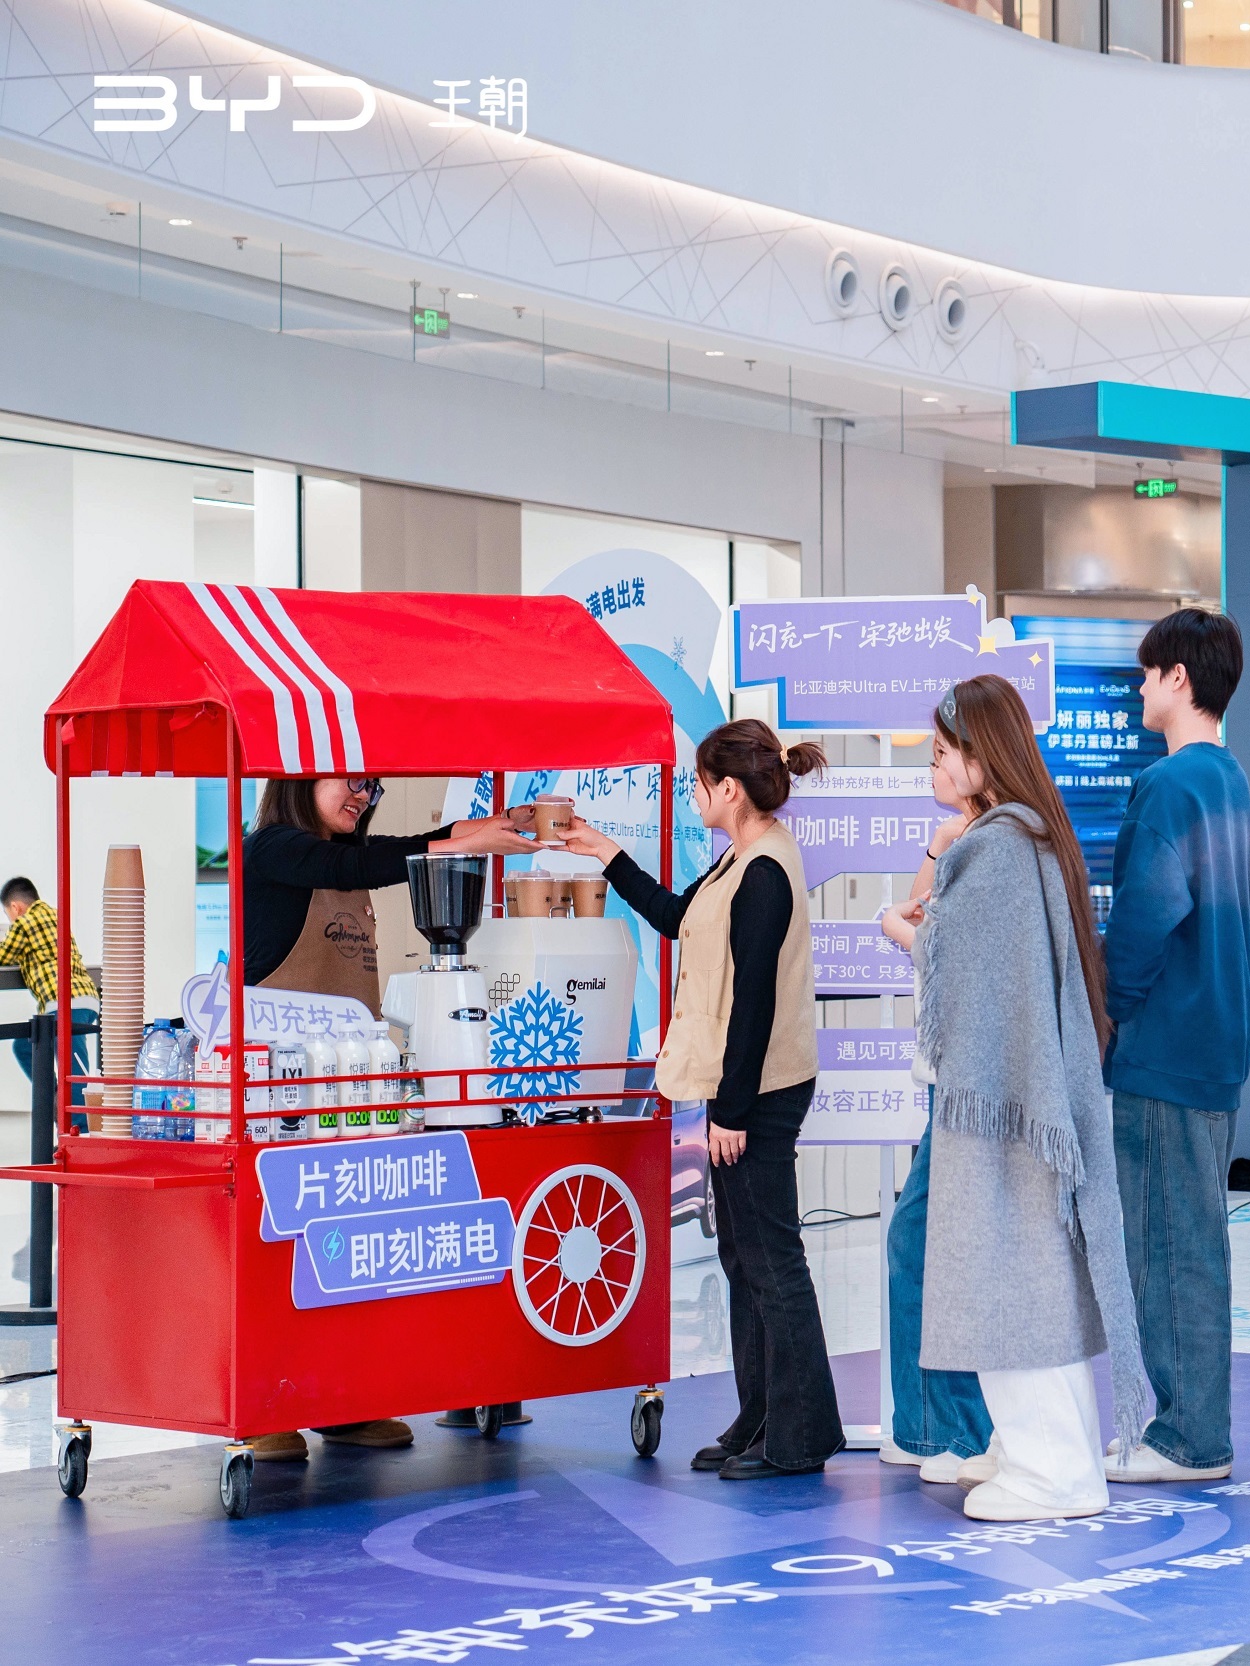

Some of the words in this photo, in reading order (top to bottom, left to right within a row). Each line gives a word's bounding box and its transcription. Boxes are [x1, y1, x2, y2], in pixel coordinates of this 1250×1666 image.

[586, 577, 646, 620] 满电出发
[748, 620, 860, 654] 闪充一下
[858, 615, 975, 653] 宋弛出发
[793, 680, 887, 696] 比亚迪宋Ultra
[1056, 710, 1129, 731] 妍丽独家
[1047, 734, 1139, 750] 伊菲丹重磅上新
[811, 776, 884, 789] 5分钟充好电
[869, 815, 954, 847] 即可
[812, 935, 850, 954] 时间
[565, 978, 606, 1006] gemilai
[249, 997, 363, 1041] 闪充技术
[837, 1041, 918, 1061] 遇见可爱
[811, 1088, 905, 1113] 妆容正好
[255, 1126, 268, 1134] 600
[295, 1149, 448, 1211] 片刻咖啡
[350, 1218, 499, 1280] 即刻满电
[949, 1567, 1188, 1617] 片刻咖啡
